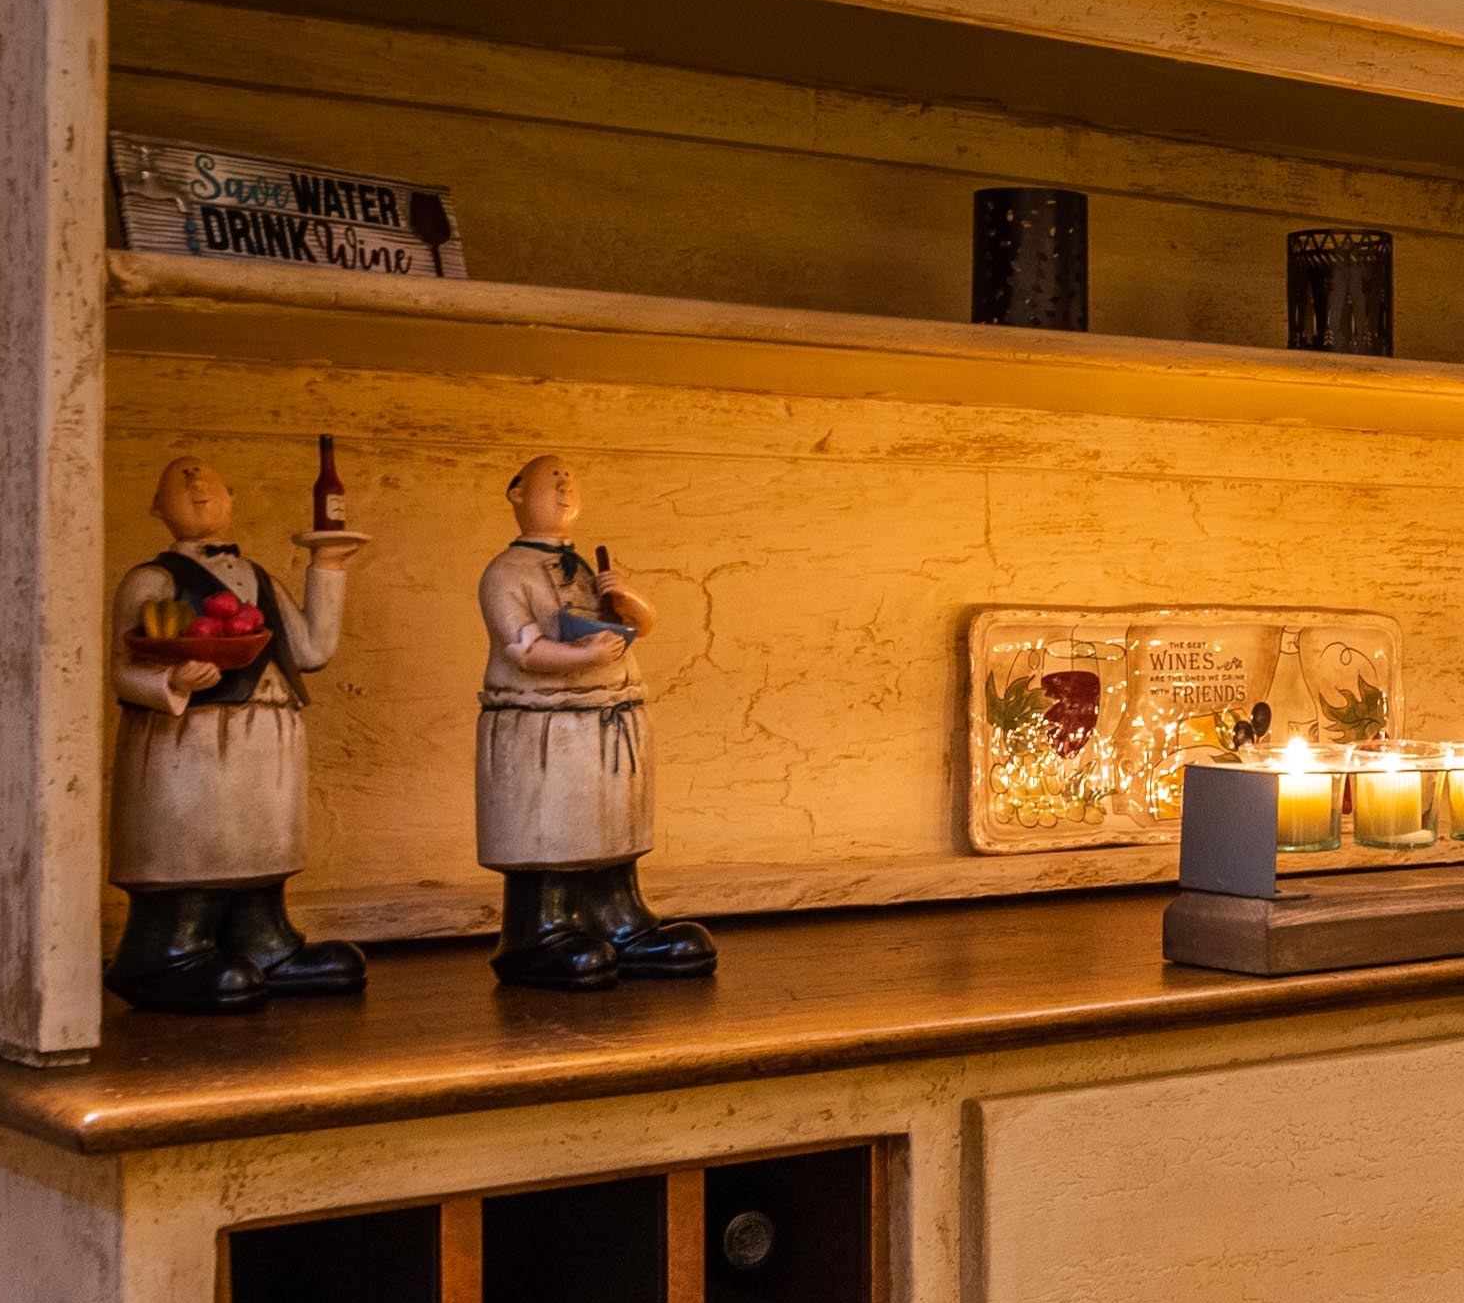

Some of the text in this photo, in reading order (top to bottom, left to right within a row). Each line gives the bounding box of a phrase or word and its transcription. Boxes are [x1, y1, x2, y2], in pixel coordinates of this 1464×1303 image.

[188, 154, 401, 227] Save WATER
[199, 205, 414, 276] DRINK Wine
[1149, 650, 1215, 671] WINES
[1184, 674, 1206, 682] ONES
[1208, 674, 1220, 682] WE
[1221, 674, 1245, 682] DRINK
[1172, 685, 1247, 704] FRIENDS
